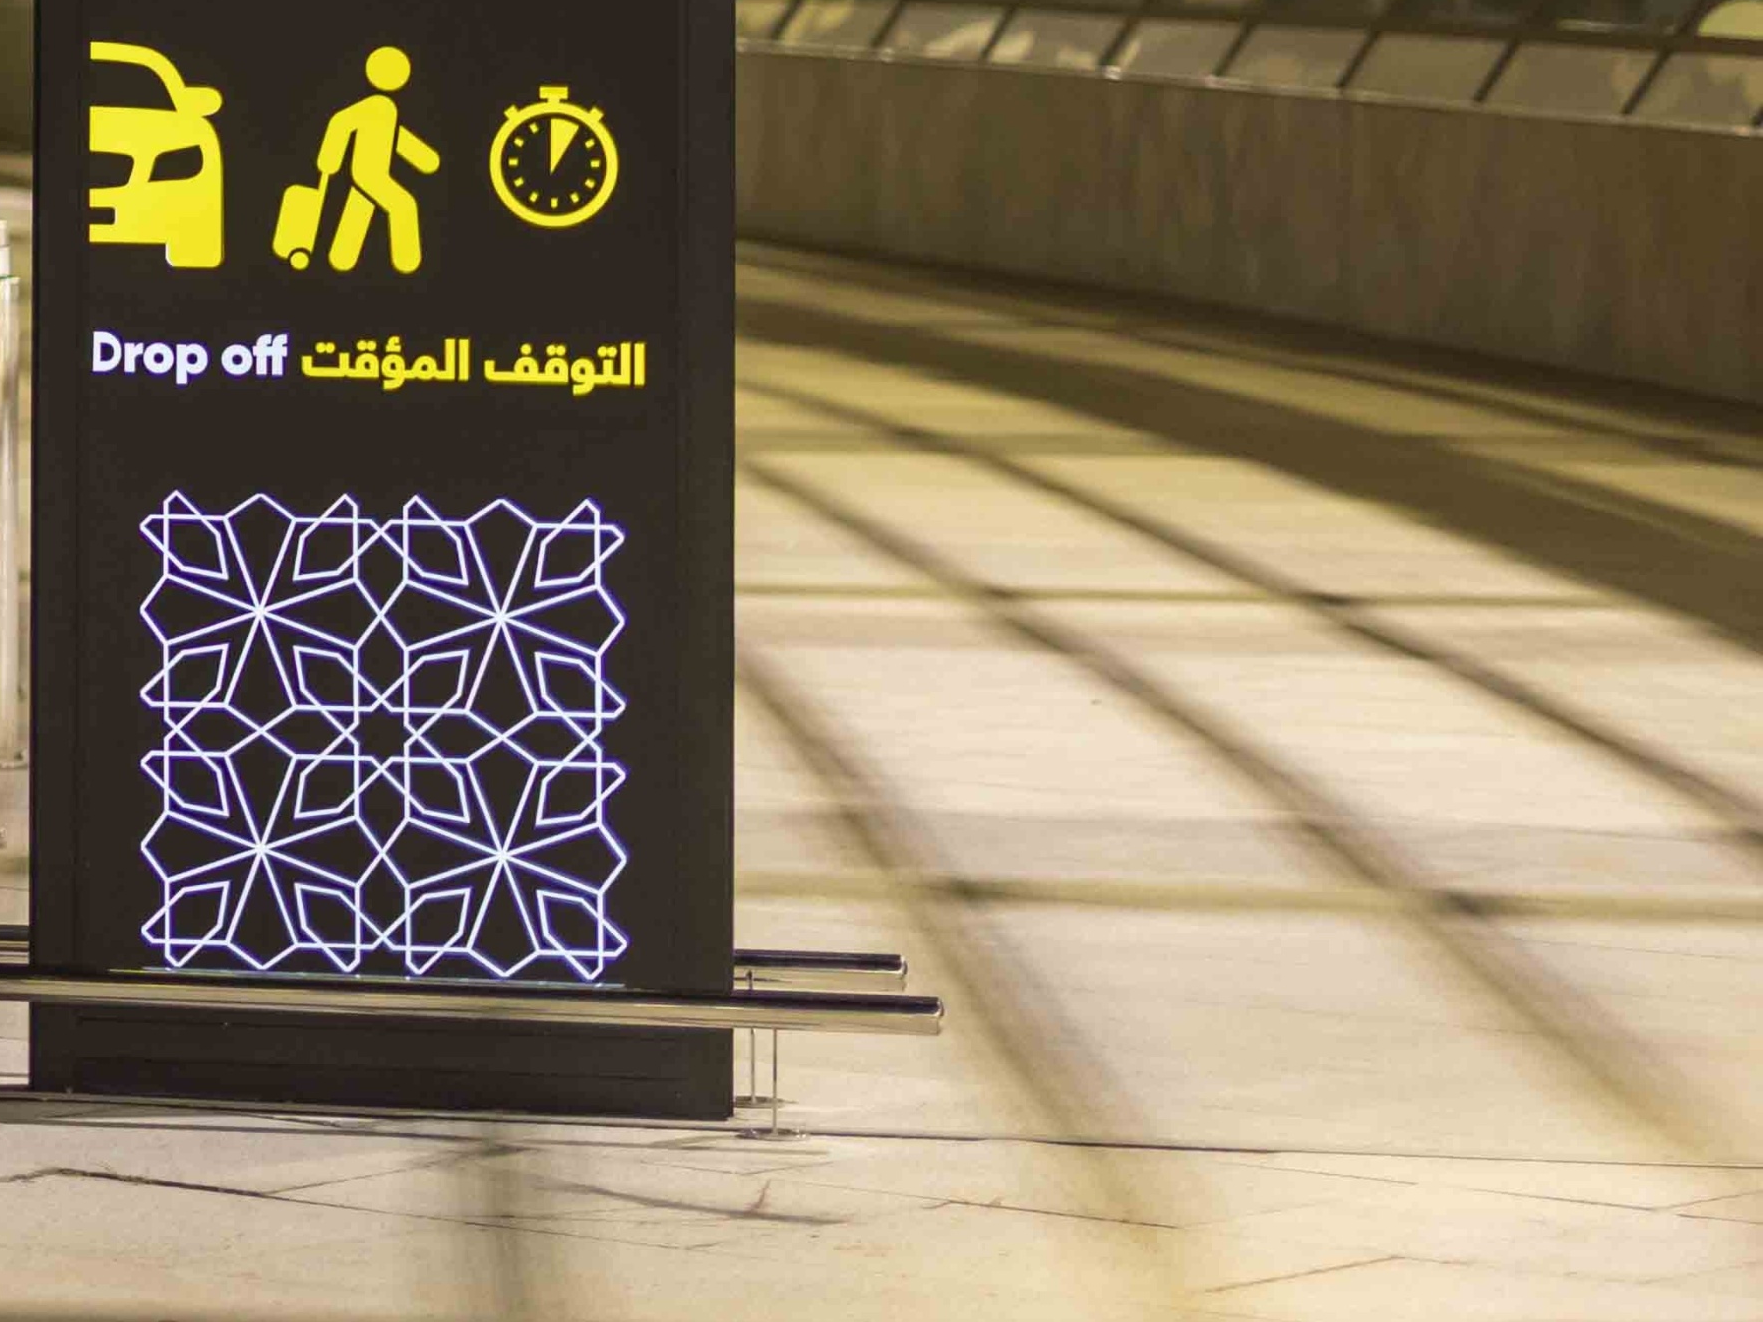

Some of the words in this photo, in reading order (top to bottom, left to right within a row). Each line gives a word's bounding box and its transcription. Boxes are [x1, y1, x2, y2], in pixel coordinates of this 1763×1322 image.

[92, 331, 209, 385] Drop
[220, 333, 289, 377] off
[300, 335, 471, 391] المؤقت
[482, 340, 647, 396] التوقف
